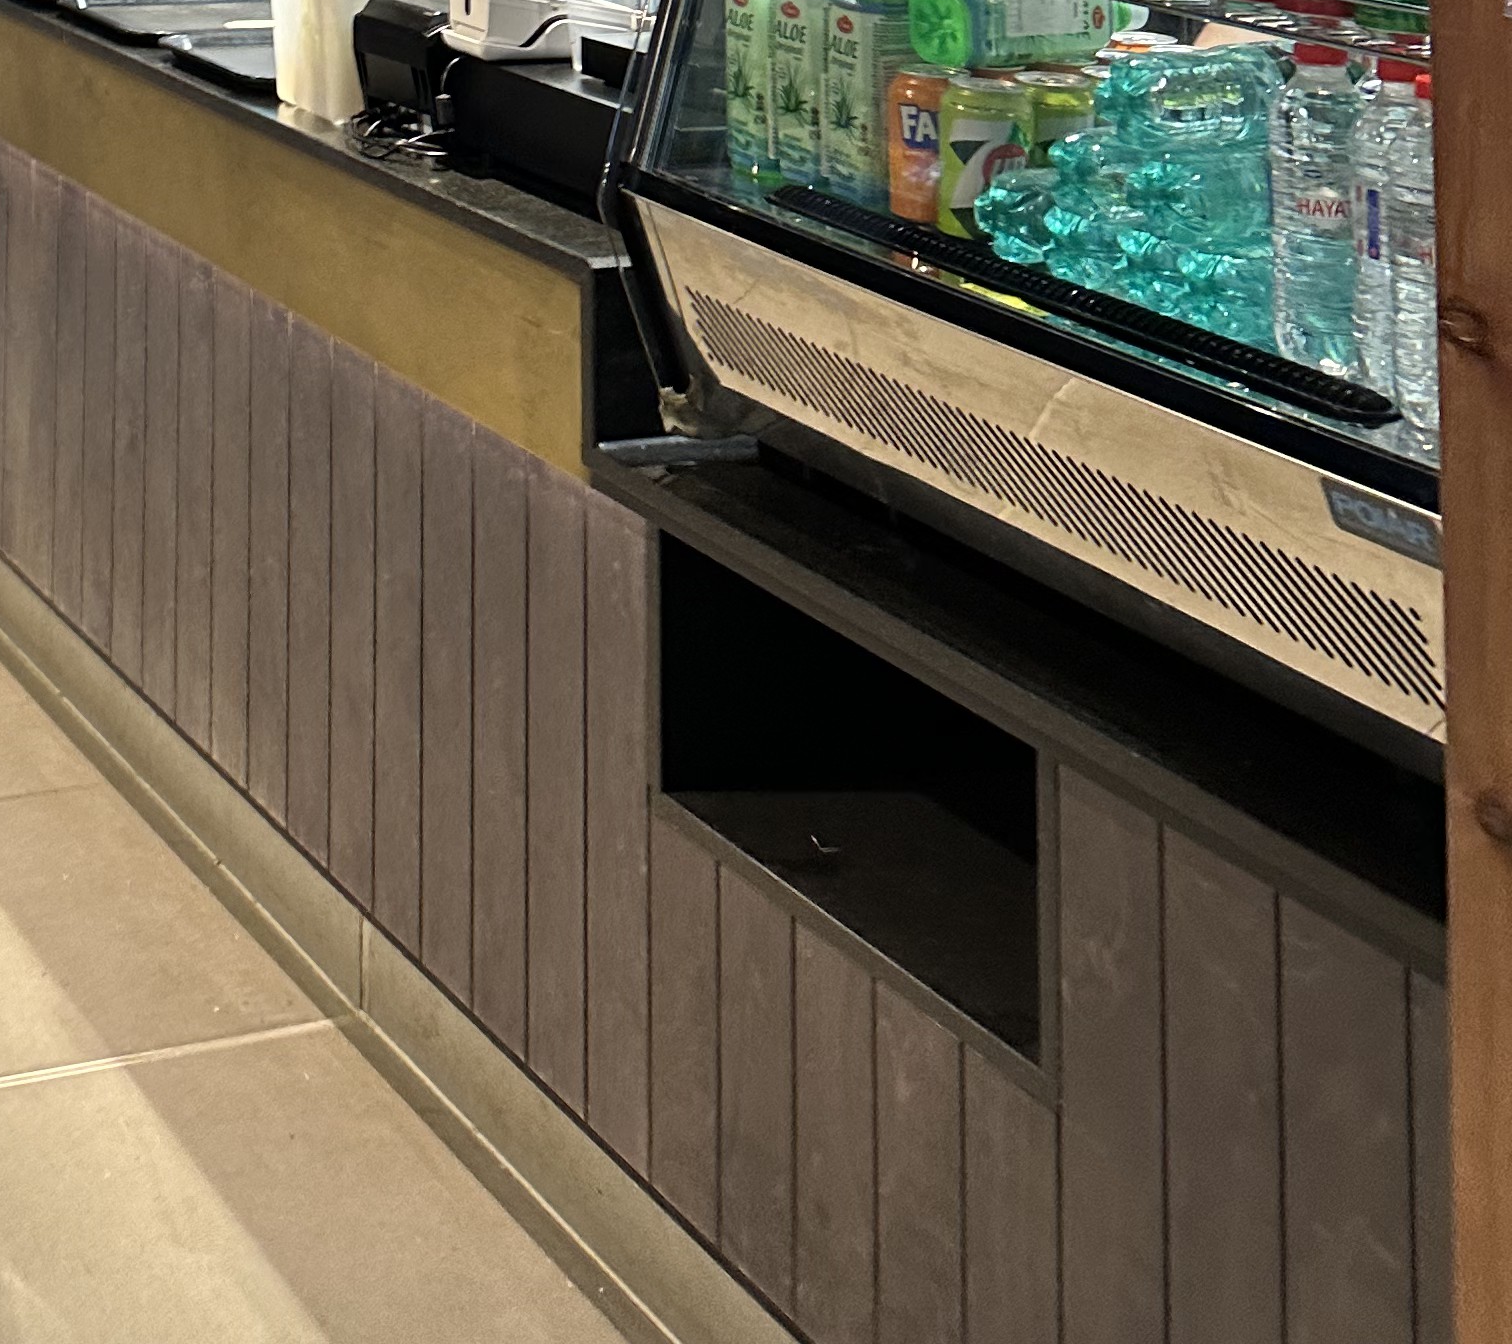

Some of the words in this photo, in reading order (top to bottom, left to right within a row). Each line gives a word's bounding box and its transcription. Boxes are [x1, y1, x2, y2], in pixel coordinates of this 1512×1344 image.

[727, 7, 755, 32] ALOE
[774, 19, 807, 45] ALOE
[831, 34, 860, 60] ALOE
